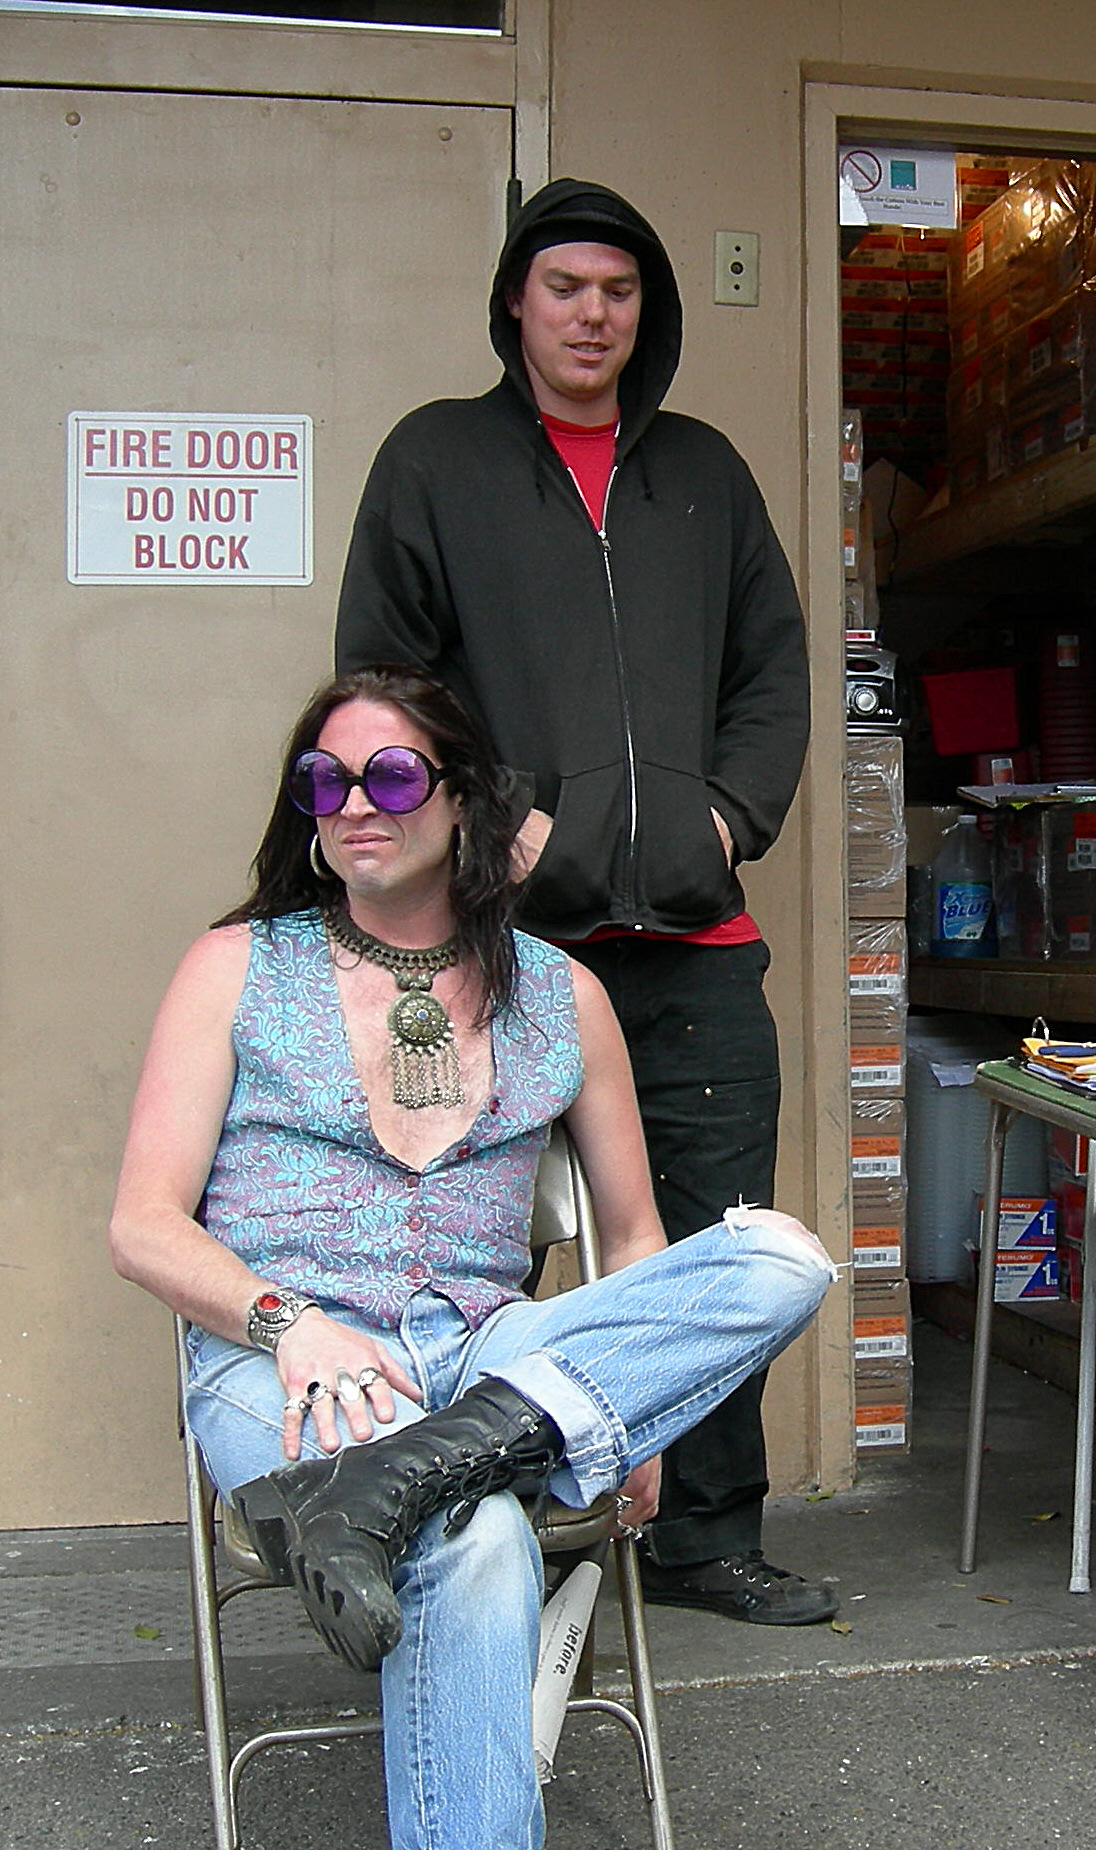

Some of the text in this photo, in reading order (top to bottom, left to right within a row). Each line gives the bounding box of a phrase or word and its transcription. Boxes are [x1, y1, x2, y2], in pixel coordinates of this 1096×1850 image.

[85, 429, 298, 470] FIRE DOOR
[126, 487, 260, 523] DO NOT
[134, 534, 250, 570] BLOCK
[1039, 1212, 1048, 1235] 1
[1042, 1263, 1051, 1286] 1
[552, 1622, 583, 1676] before.
